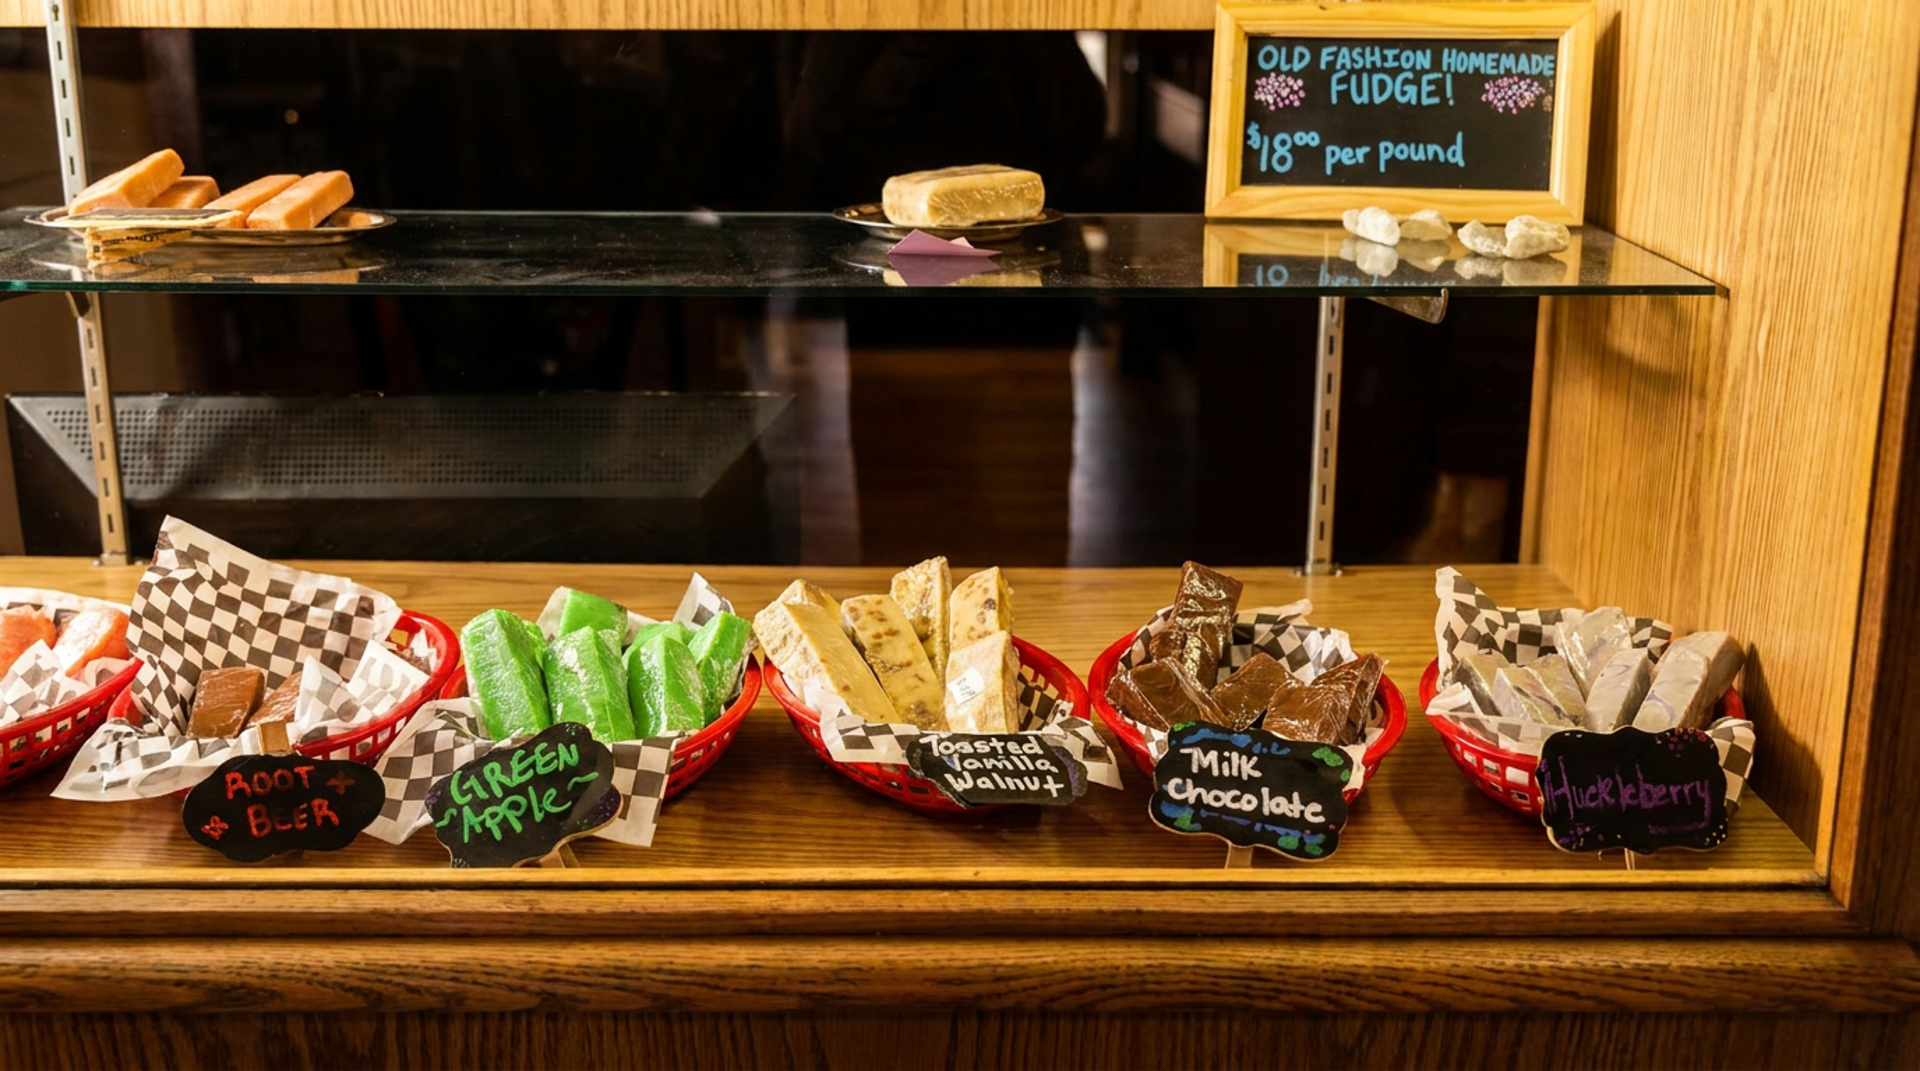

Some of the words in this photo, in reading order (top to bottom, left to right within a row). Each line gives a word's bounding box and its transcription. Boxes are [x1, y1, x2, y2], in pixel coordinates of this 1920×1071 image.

[1257, 44, 1311, 72] OLD
[1319, 45, 1431, 71] FASHION
[1441, 48, 1555, 77] HOMEMADE
[1330, 69, 1455, 106] FUDGE!
[1325, 144, 1371, 175] per
[1378, 131, 1465, 172] pound
[919, 733, 1044, 757] Toasted
[450, 742, 579, 805] GREEN
[942, 752, 1060, 774] Vanilla
[1179, 747, 1262, 780] Milk
[225, 765, 315, 800] ROOT
[944, 770, 1065, 798] Walnut
[1543, 755, 1711, 834] Huckleberry
[246, 798, 340, 838] BEER
